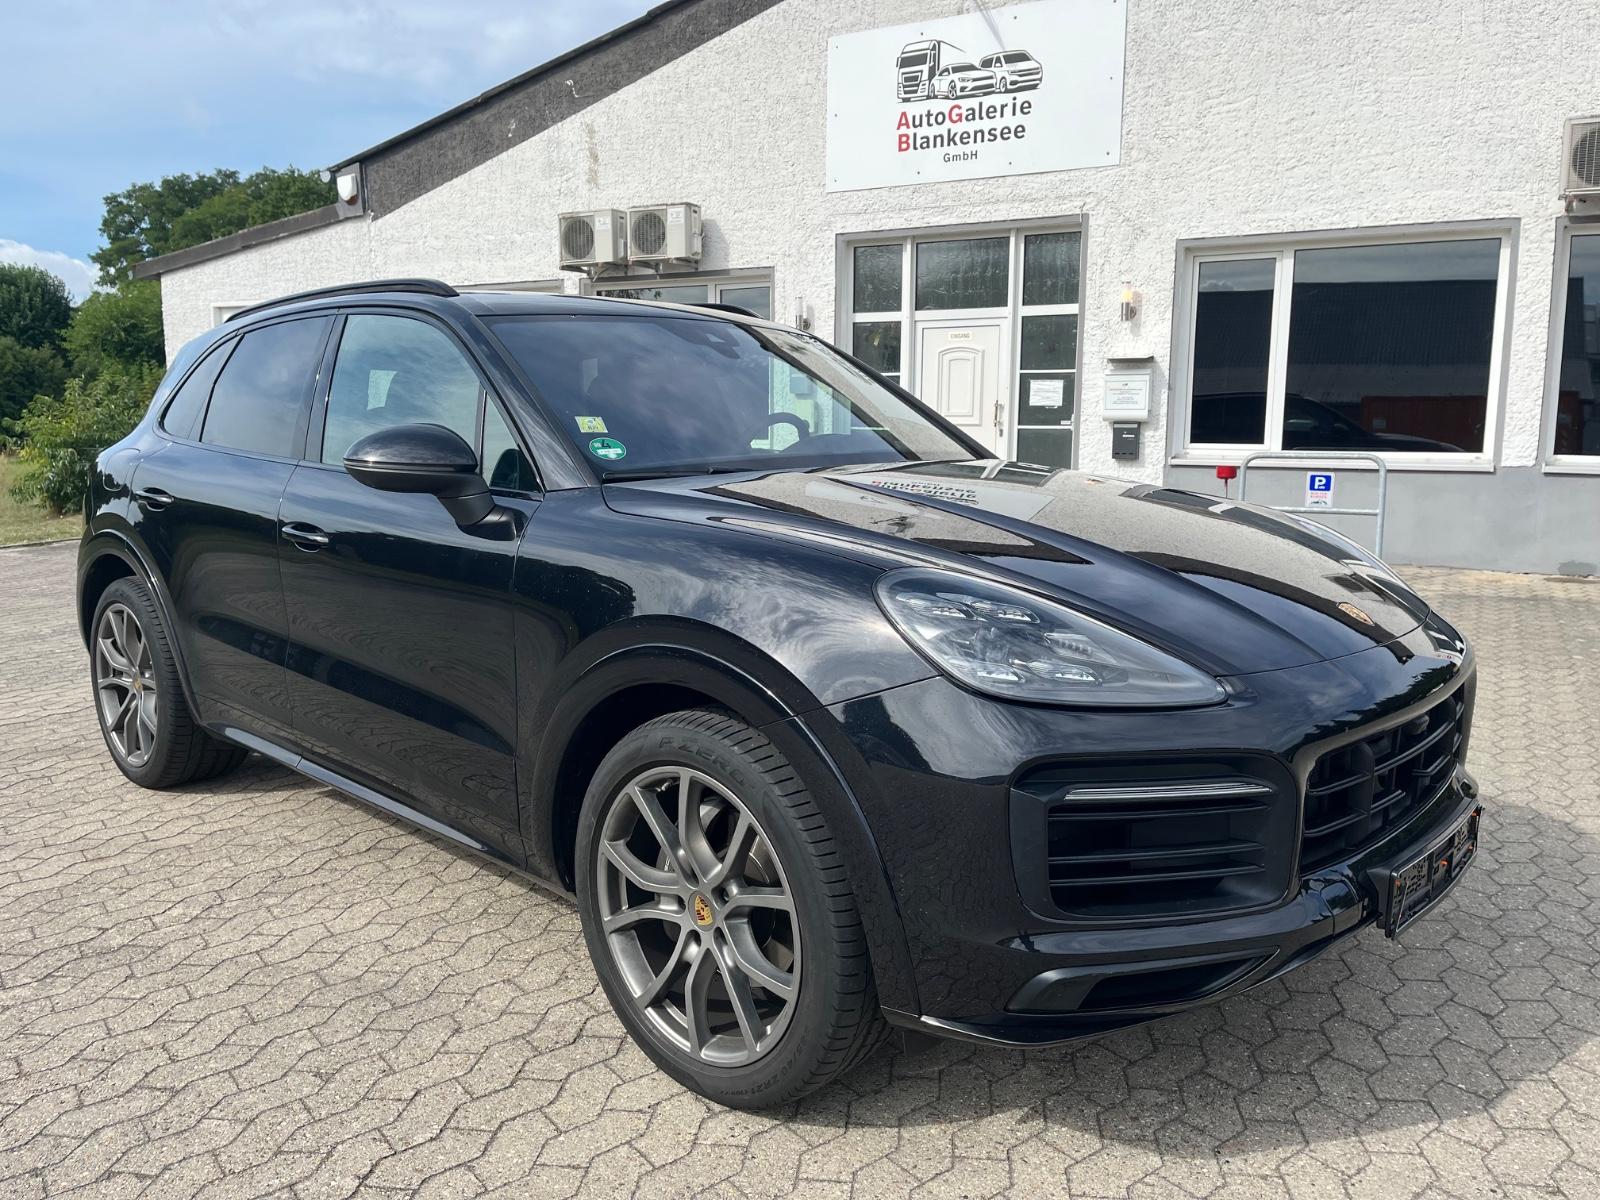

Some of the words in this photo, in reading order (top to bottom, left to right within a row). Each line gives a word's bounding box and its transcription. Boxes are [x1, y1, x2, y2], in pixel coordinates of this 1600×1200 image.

[896, 96, 1032, 130] AutoGalerie
[897, 123, 1026, 152] Blankensee
[943, 150, 978, 163] GmbH
[1314, 476, 1326, 490] P
